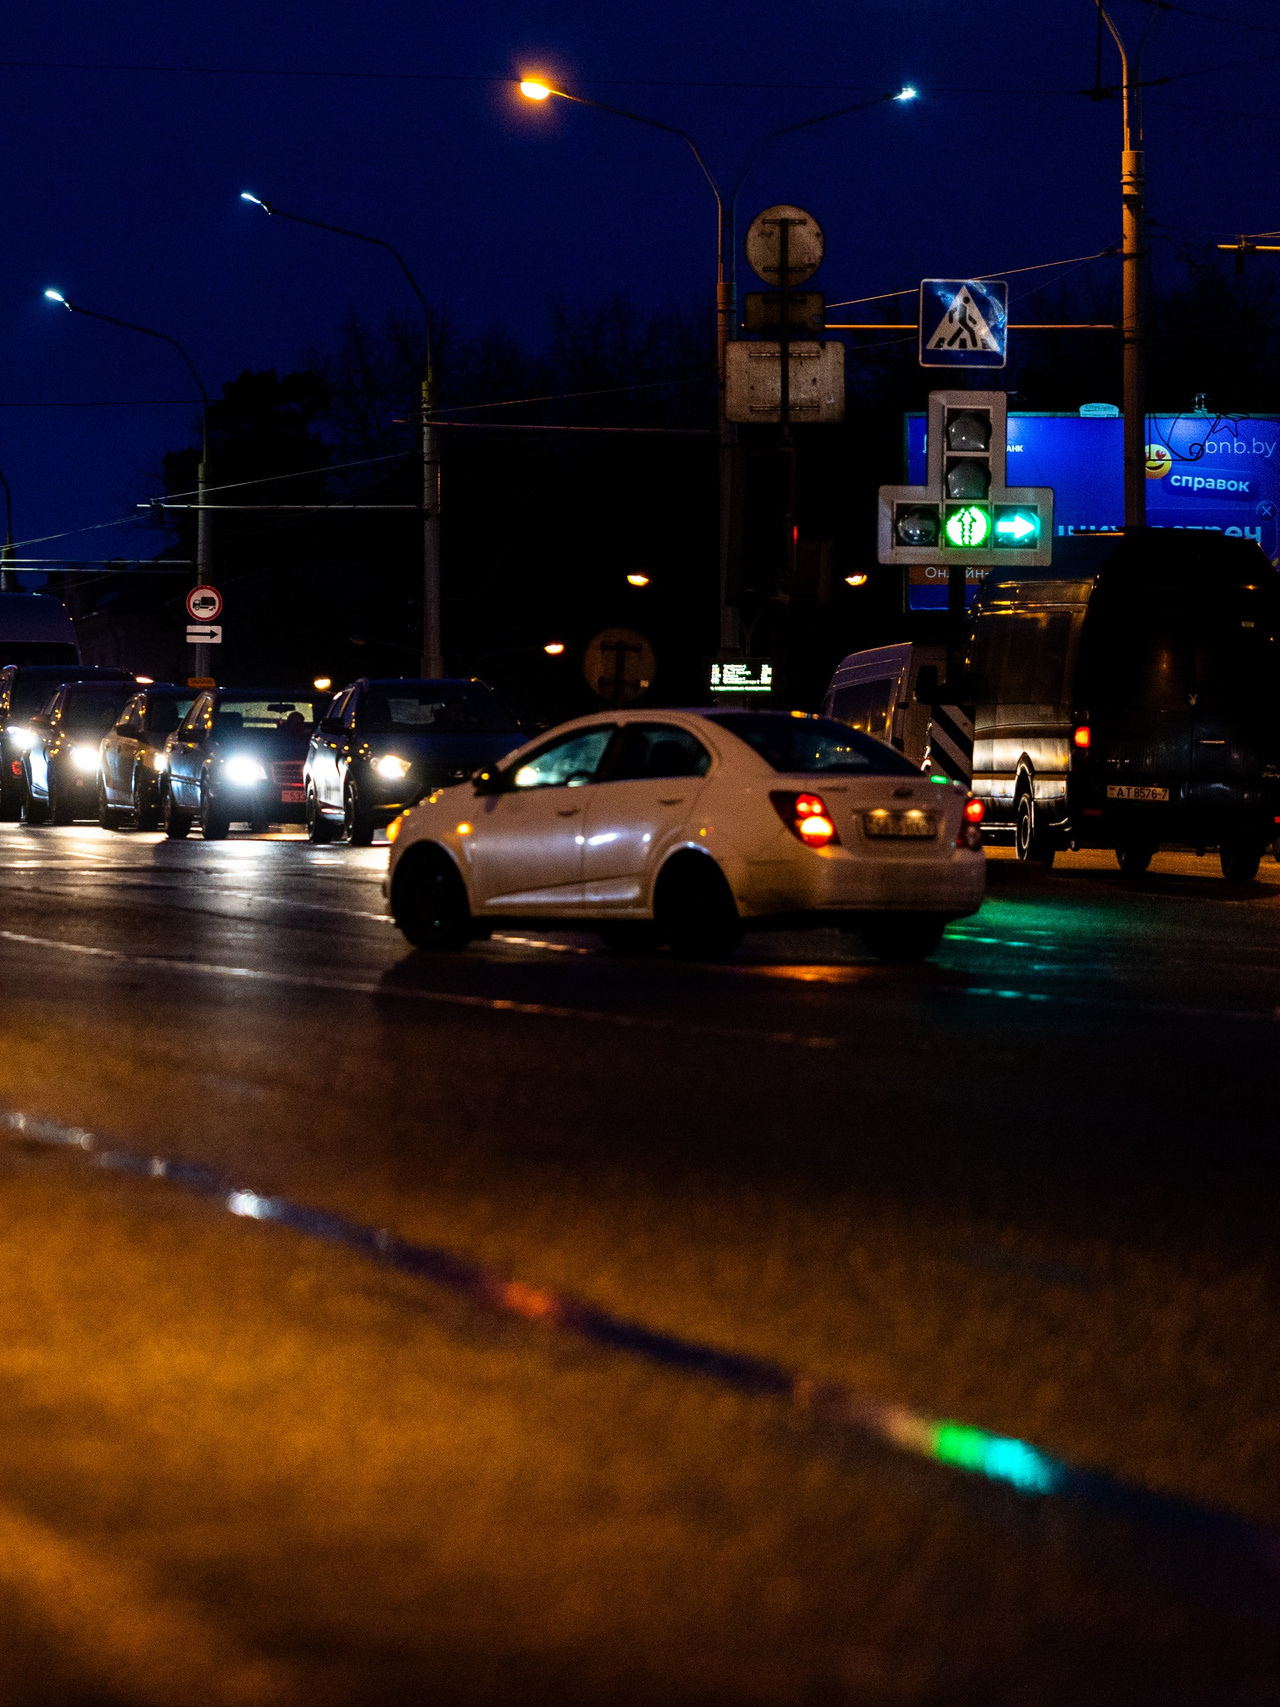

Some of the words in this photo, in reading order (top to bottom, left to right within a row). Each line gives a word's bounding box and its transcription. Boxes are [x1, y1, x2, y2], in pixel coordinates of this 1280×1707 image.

[1006, 444, 1023, 453] АНК
[1205, 437, 1277, 458] bnb.by
[1170, 475, 1250, 493] справок
[925, 566, 990, 578] Онйн-
[1134, 788, 1168, 799] 8576-7
